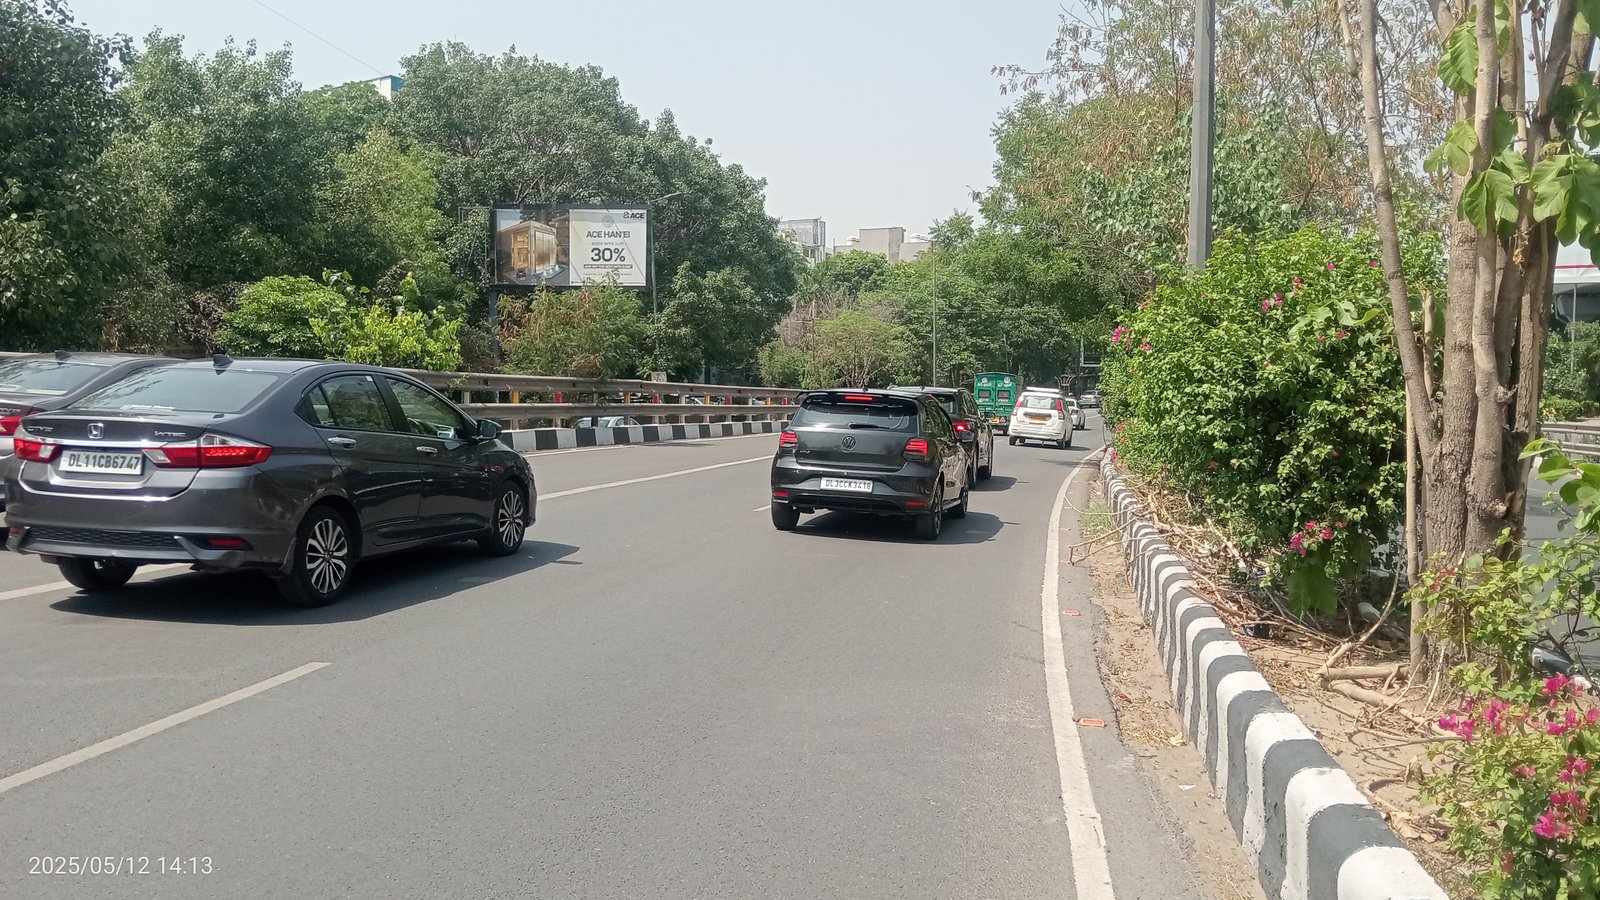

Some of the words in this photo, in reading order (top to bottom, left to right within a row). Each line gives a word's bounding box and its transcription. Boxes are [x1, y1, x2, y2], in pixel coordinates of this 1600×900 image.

[586, 230, 602, 238] ACE
[591, 247, 625, 262] 30%
[68, 453, 140, 470] DL11CB6747
[825, 479, 872, 490] DL3CCK3418
